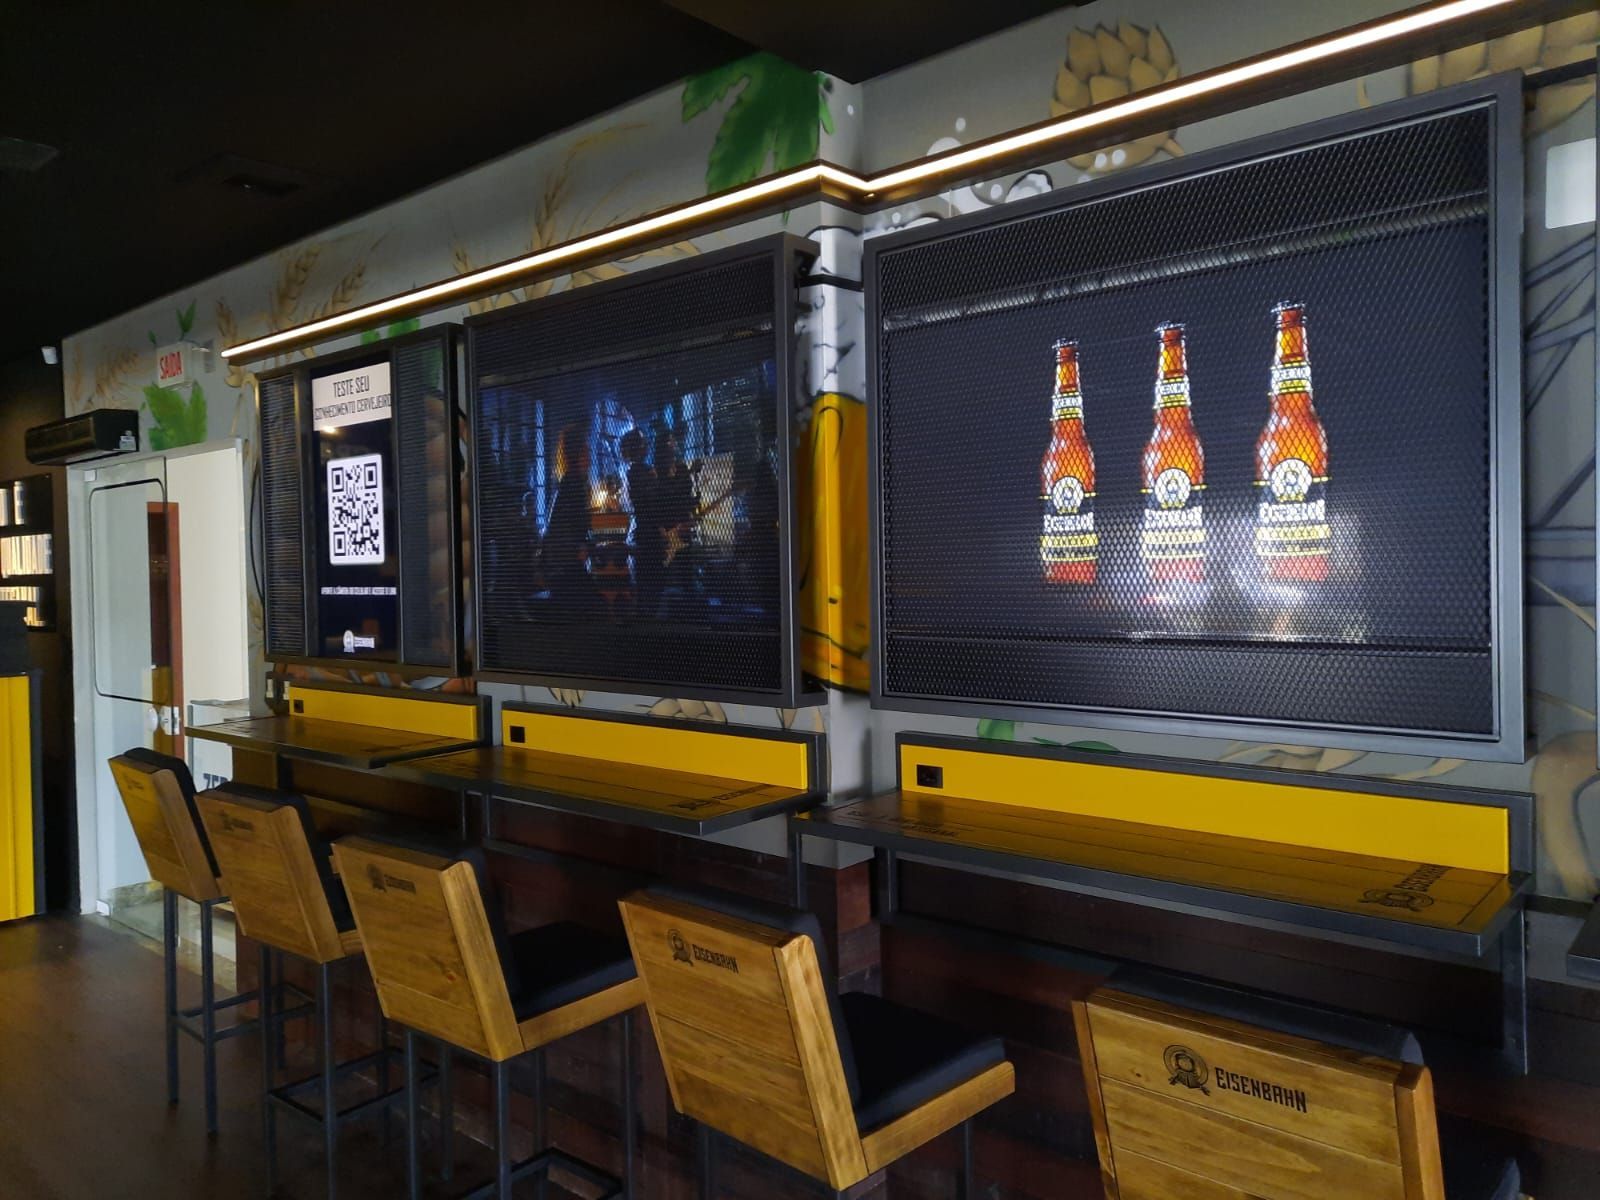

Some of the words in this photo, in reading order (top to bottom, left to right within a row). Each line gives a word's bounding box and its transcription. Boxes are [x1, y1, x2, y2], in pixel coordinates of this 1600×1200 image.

[333, 379, 354, 398] TESTE
[355, 375, 370, 393] SEU
[1214, 1066, 1308, 1113] EISENBAHN
